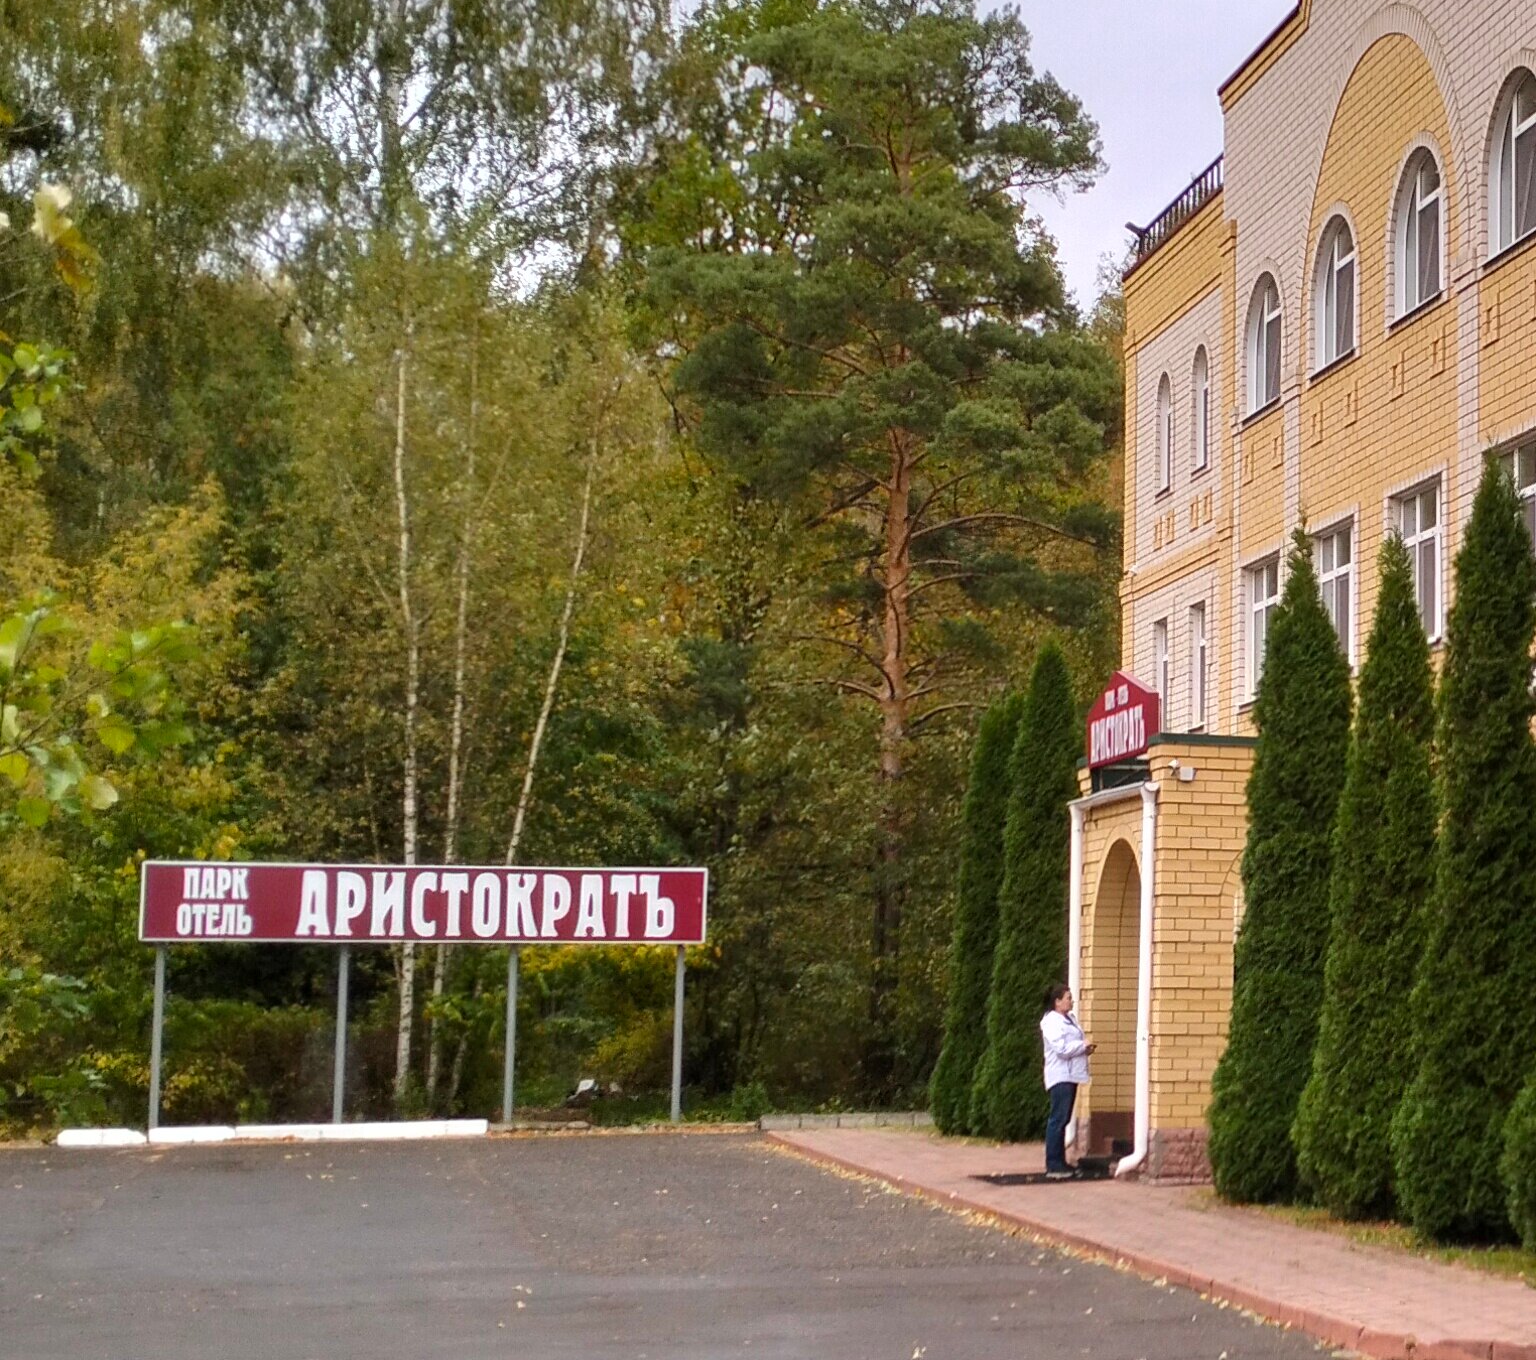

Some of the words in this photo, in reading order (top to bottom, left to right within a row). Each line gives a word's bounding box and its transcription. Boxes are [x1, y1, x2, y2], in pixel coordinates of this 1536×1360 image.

[183, 867, 249, 900] ПАРК
[176, 903, 253, 936] ОТЕЛЬ
[294, 869, 675, 938] АРИСТОКРАТЪ
